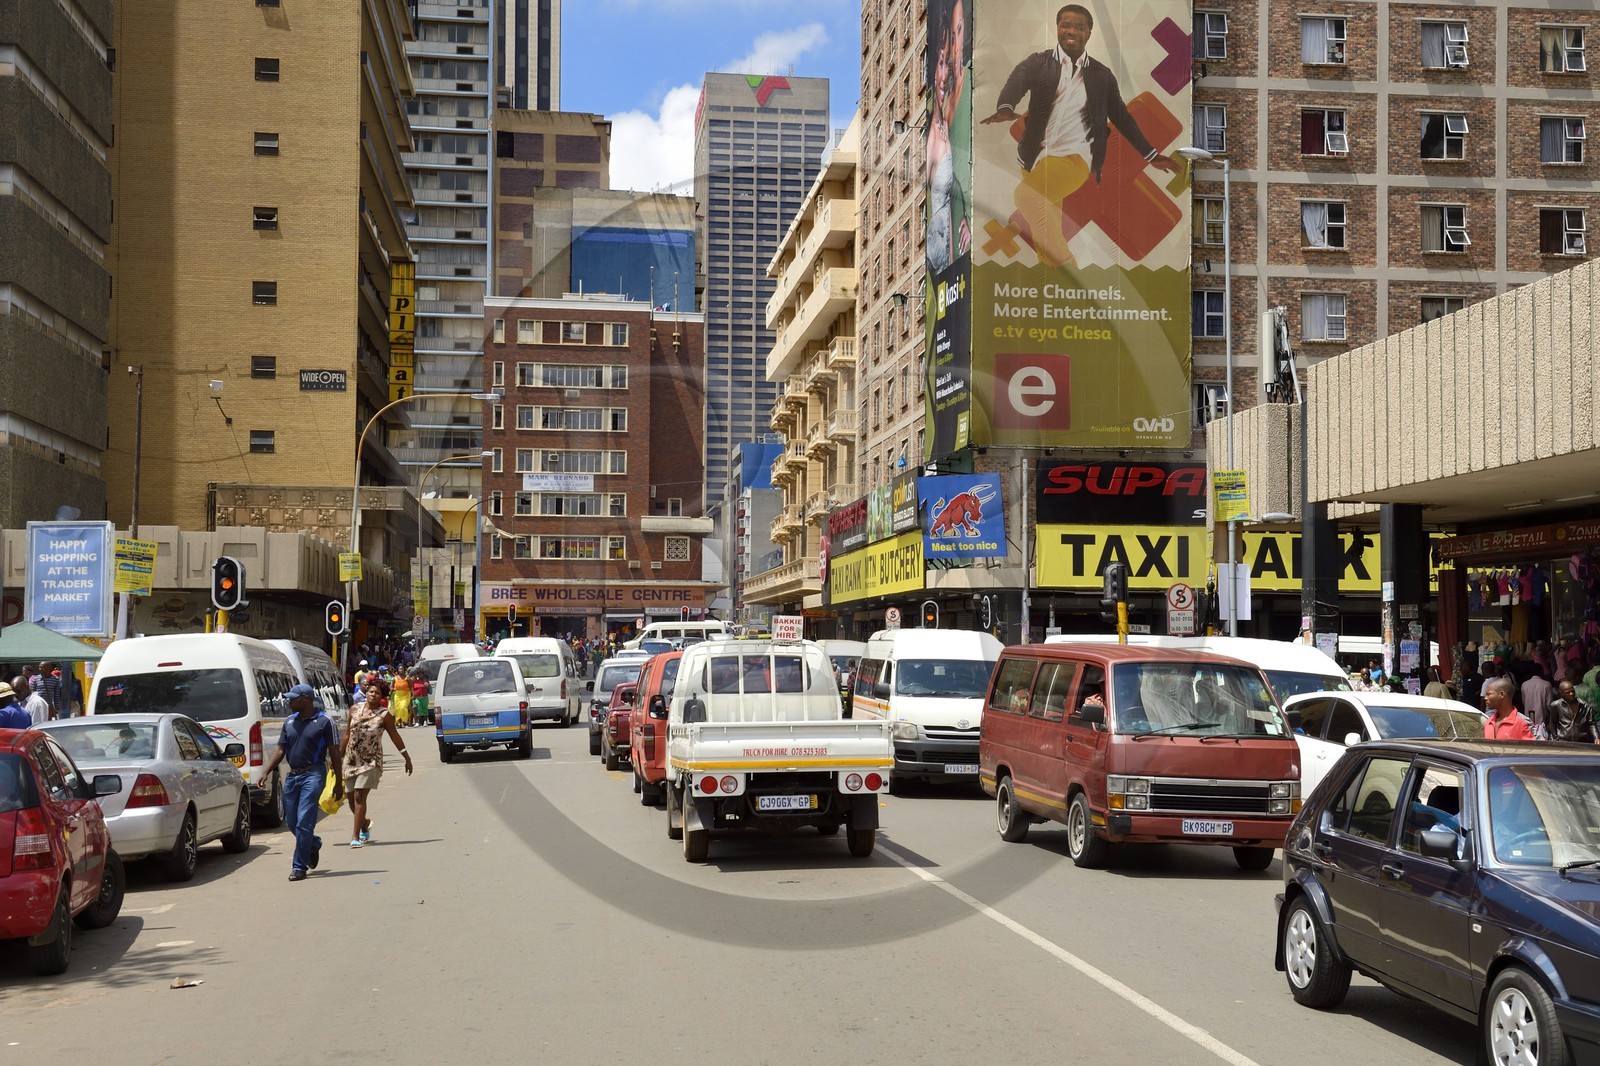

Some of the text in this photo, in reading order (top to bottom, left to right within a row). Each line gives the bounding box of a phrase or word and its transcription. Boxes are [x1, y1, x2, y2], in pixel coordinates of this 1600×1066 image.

[994, 283, 1126, 300] More Channels.
[994, 303, 1172, 321] More Entertainment.
[993, 325, 1112, 342] e.tv eya Chesa
[301, 372, 319, 382] WIDE
[1008, 366, 1056, 416] e
[1043, 466, 1207, 496] SUPA
[1192, 509, 1206, 519] S
[50, 540, 87, 549] HAPPY
[931, 541, 998, 551] Meat too nice
[39, 553, 97, 562] SHOPPING
[1061, 534, 1189, 578] TAXI
[48, 567, 88, 575] AT THE
[832, 566, 844, 595] TAXI
[845, 560, 862, 592] RANK
[880, 541, 922, 584] BUTCHERY
[42, 580, 94, 588] TRADERS
[45, 593, 90, 602] MARKET
[491, 588, 527, 599] BREE
[535, 588, 623, 600] WHOLESALE
[632, 589, 692, 600] CENTRE
[743, 748, 761, 756] TRUCK
[762, 748, 773, 756] FOR
[774, 748, 788, 756] HIRE
[798, 797, 809, 807] GP
[1184, 822, 1232, 833] BK98CH GP
